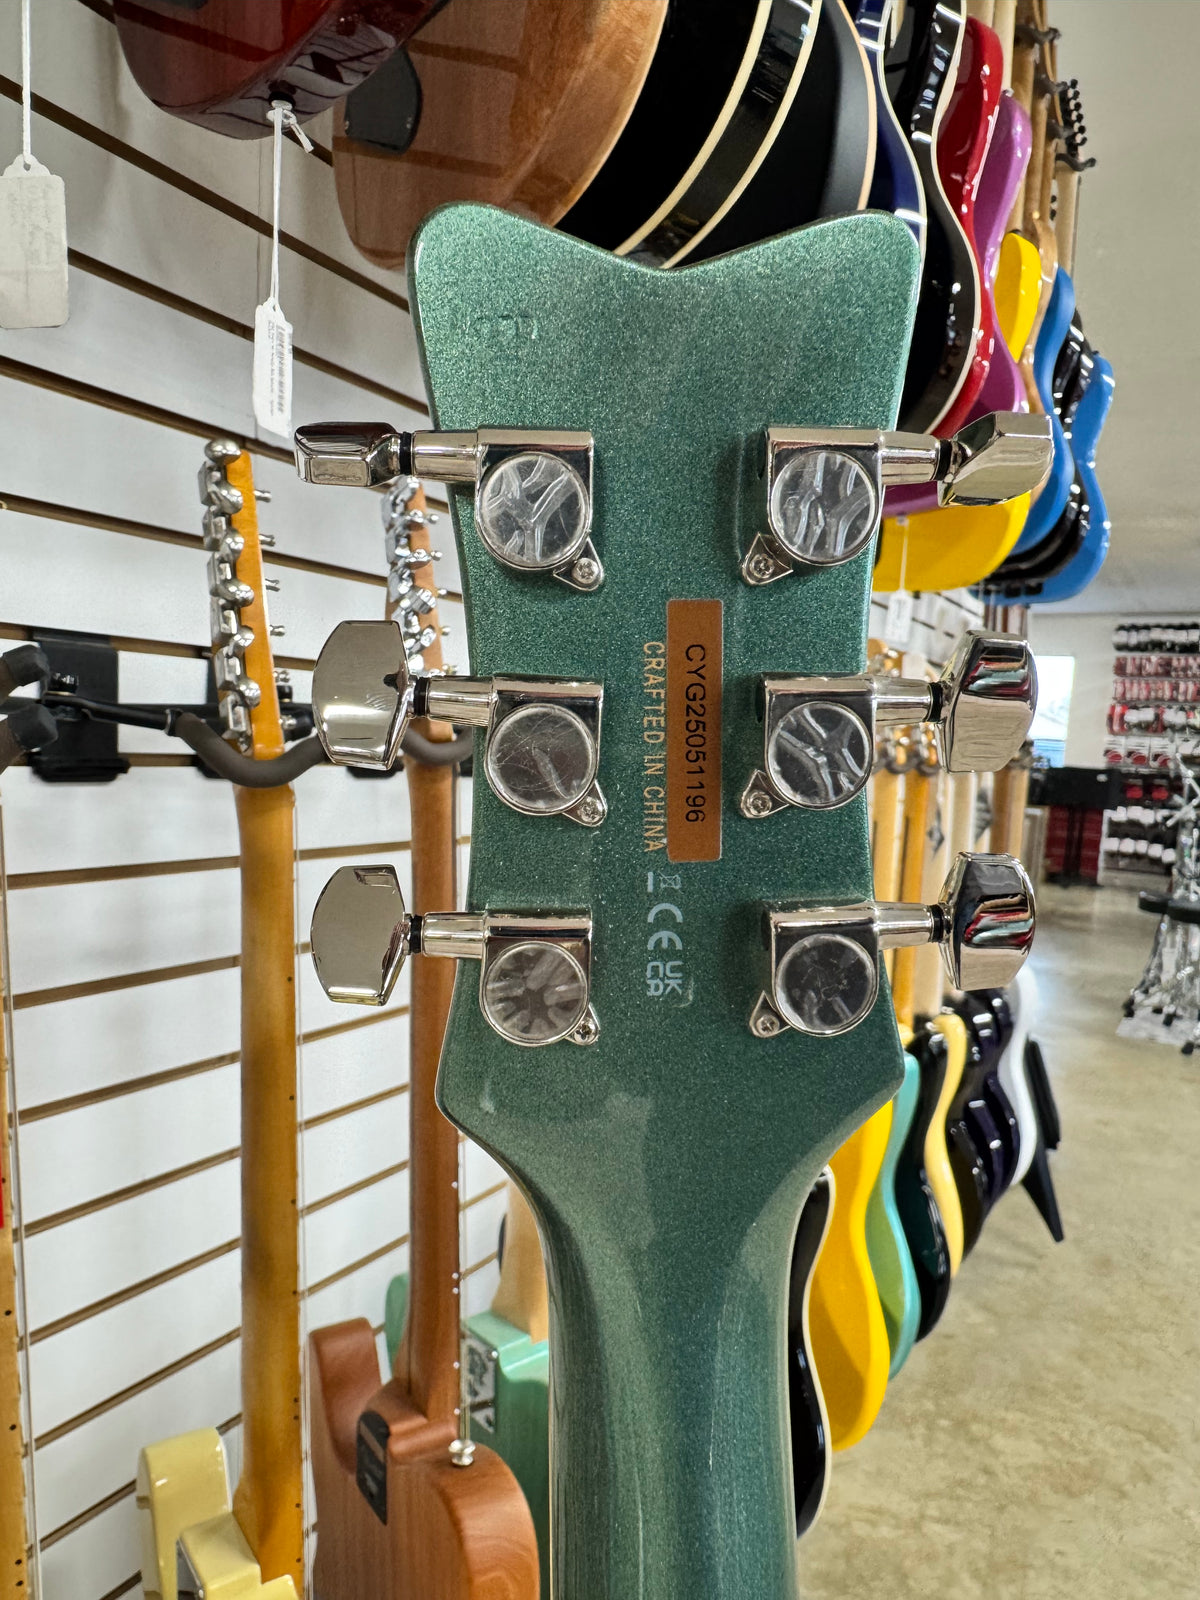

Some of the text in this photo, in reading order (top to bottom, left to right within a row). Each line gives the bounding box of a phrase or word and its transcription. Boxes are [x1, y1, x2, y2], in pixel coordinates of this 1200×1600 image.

[643, 641, 665, 852] CRAFTED IN CHINA
[685, 644, 706, 822] CYG25051196
[647, 902, 683, 950] CE
